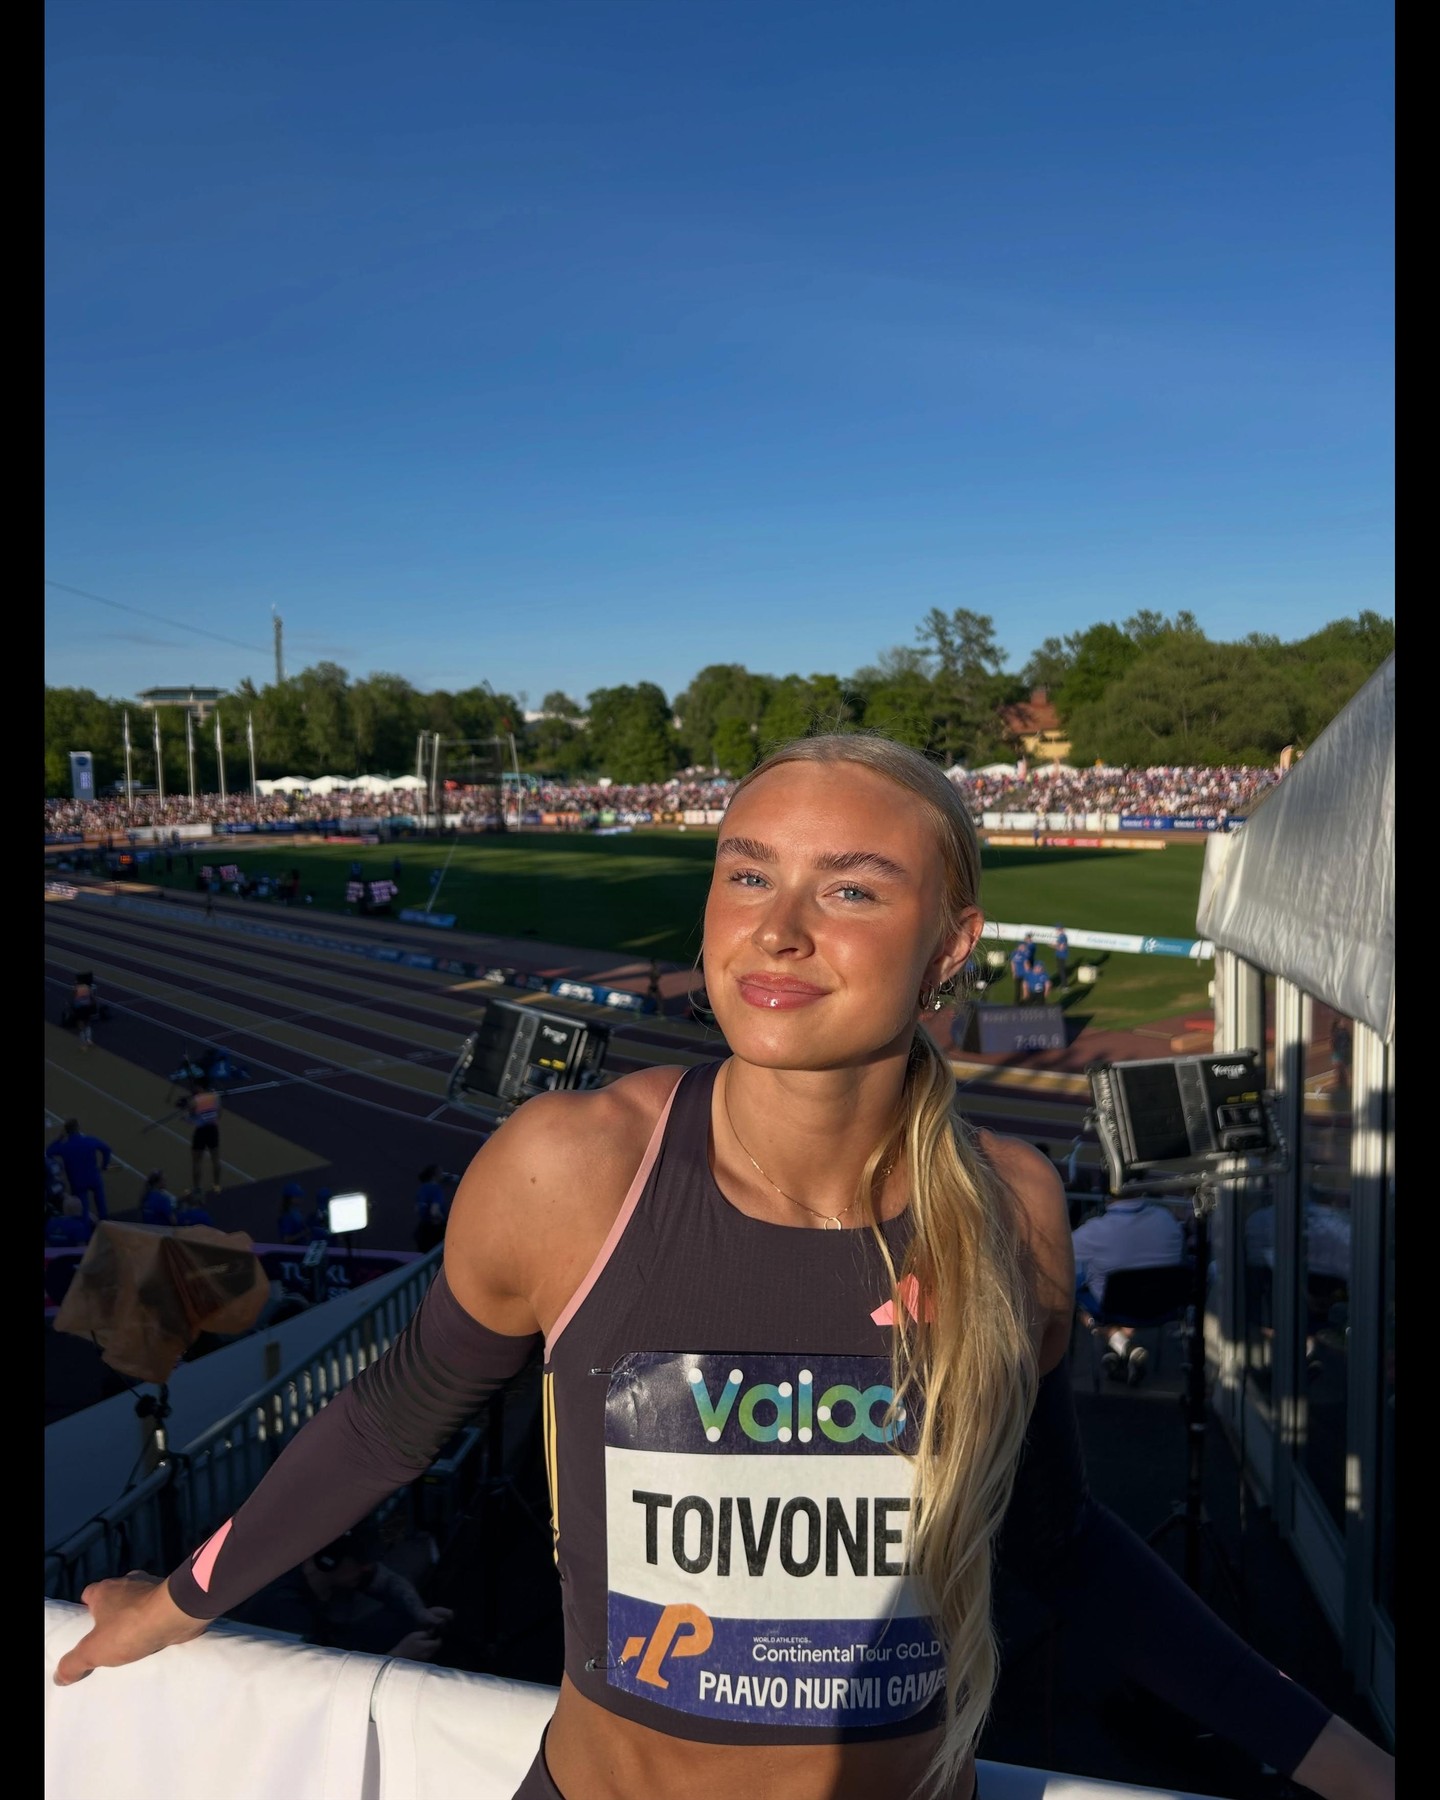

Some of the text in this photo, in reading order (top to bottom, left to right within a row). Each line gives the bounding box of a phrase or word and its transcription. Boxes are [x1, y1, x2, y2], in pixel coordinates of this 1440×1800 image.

[632, 1489, 924, 1577] TOIVONE
[752, 1640, 941, 1663] Continental Tour GOLD
[699, 1670, 788, 1709] PAAVO
[794, 1677, 881, 1710] NURMI
